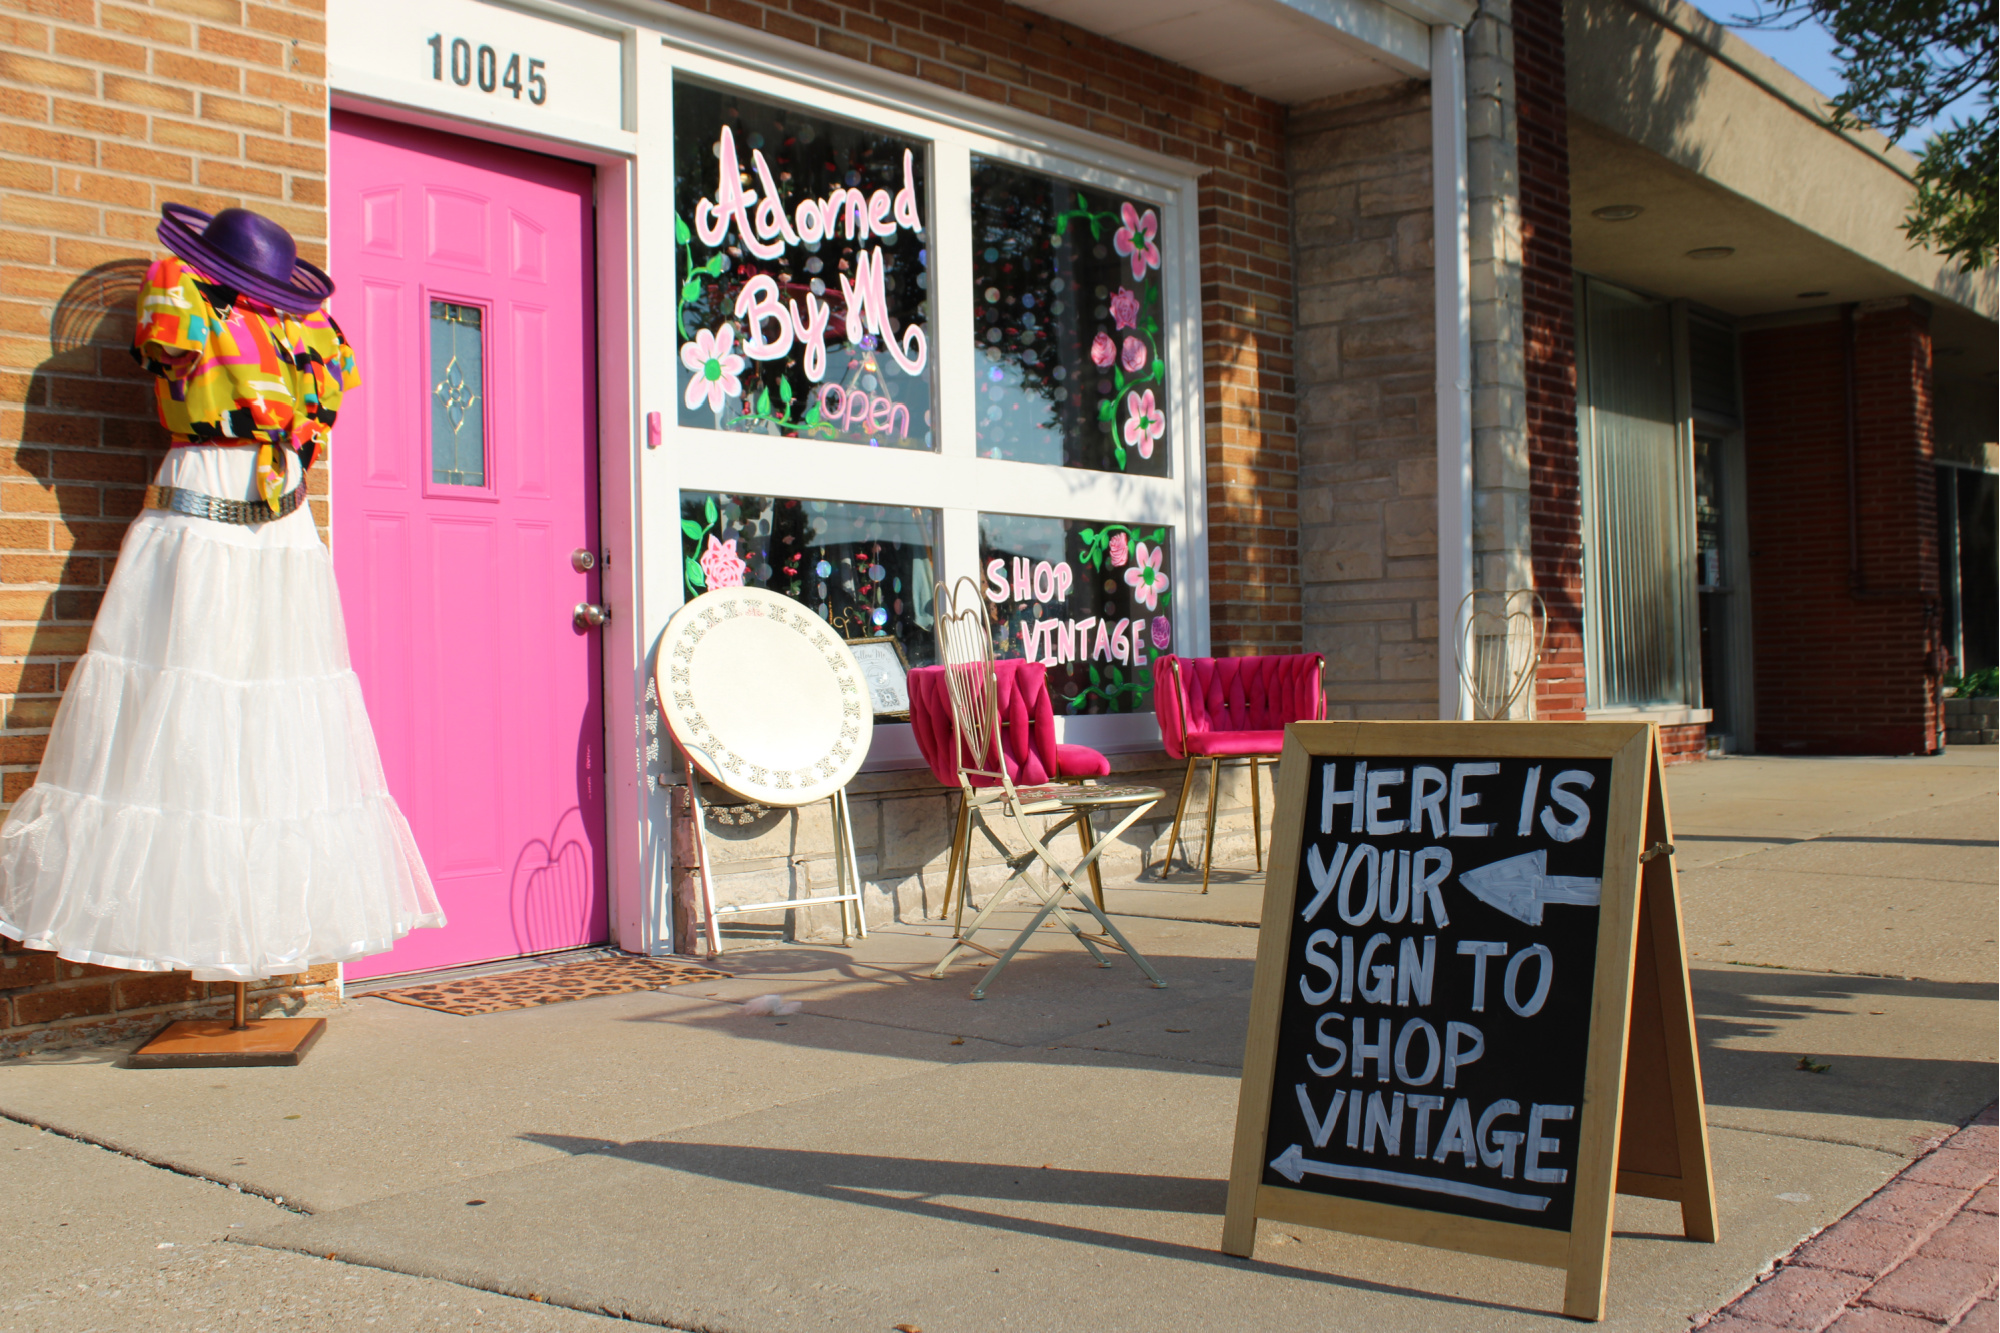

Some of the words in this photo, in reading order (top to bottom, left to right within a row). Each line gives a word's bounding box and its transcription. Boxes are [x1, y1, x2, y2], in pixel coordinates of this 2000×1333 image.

[426, 31, 548, 106] 10045
[694, 124, 922, 260] Adorned
[734, 273, 830, 383] By
[839, 245, 928, 377] M
[985, 556, 1073, 604] SHOP
[1021, 615, 1148, 668] VINTAGE
[1320, 761, 1500, 840] HERE
[1516, 764, 1596, 843] IS
[1300, 841, 1454, 929] YOUR
[1299, 928, 1437, 1007] SIGN
[1456, 940, 1554, 1018] TO
[1306, 1011, 1485, 1090] SHOP
[1295, 1083, 1576, 1185] VINTAGE
